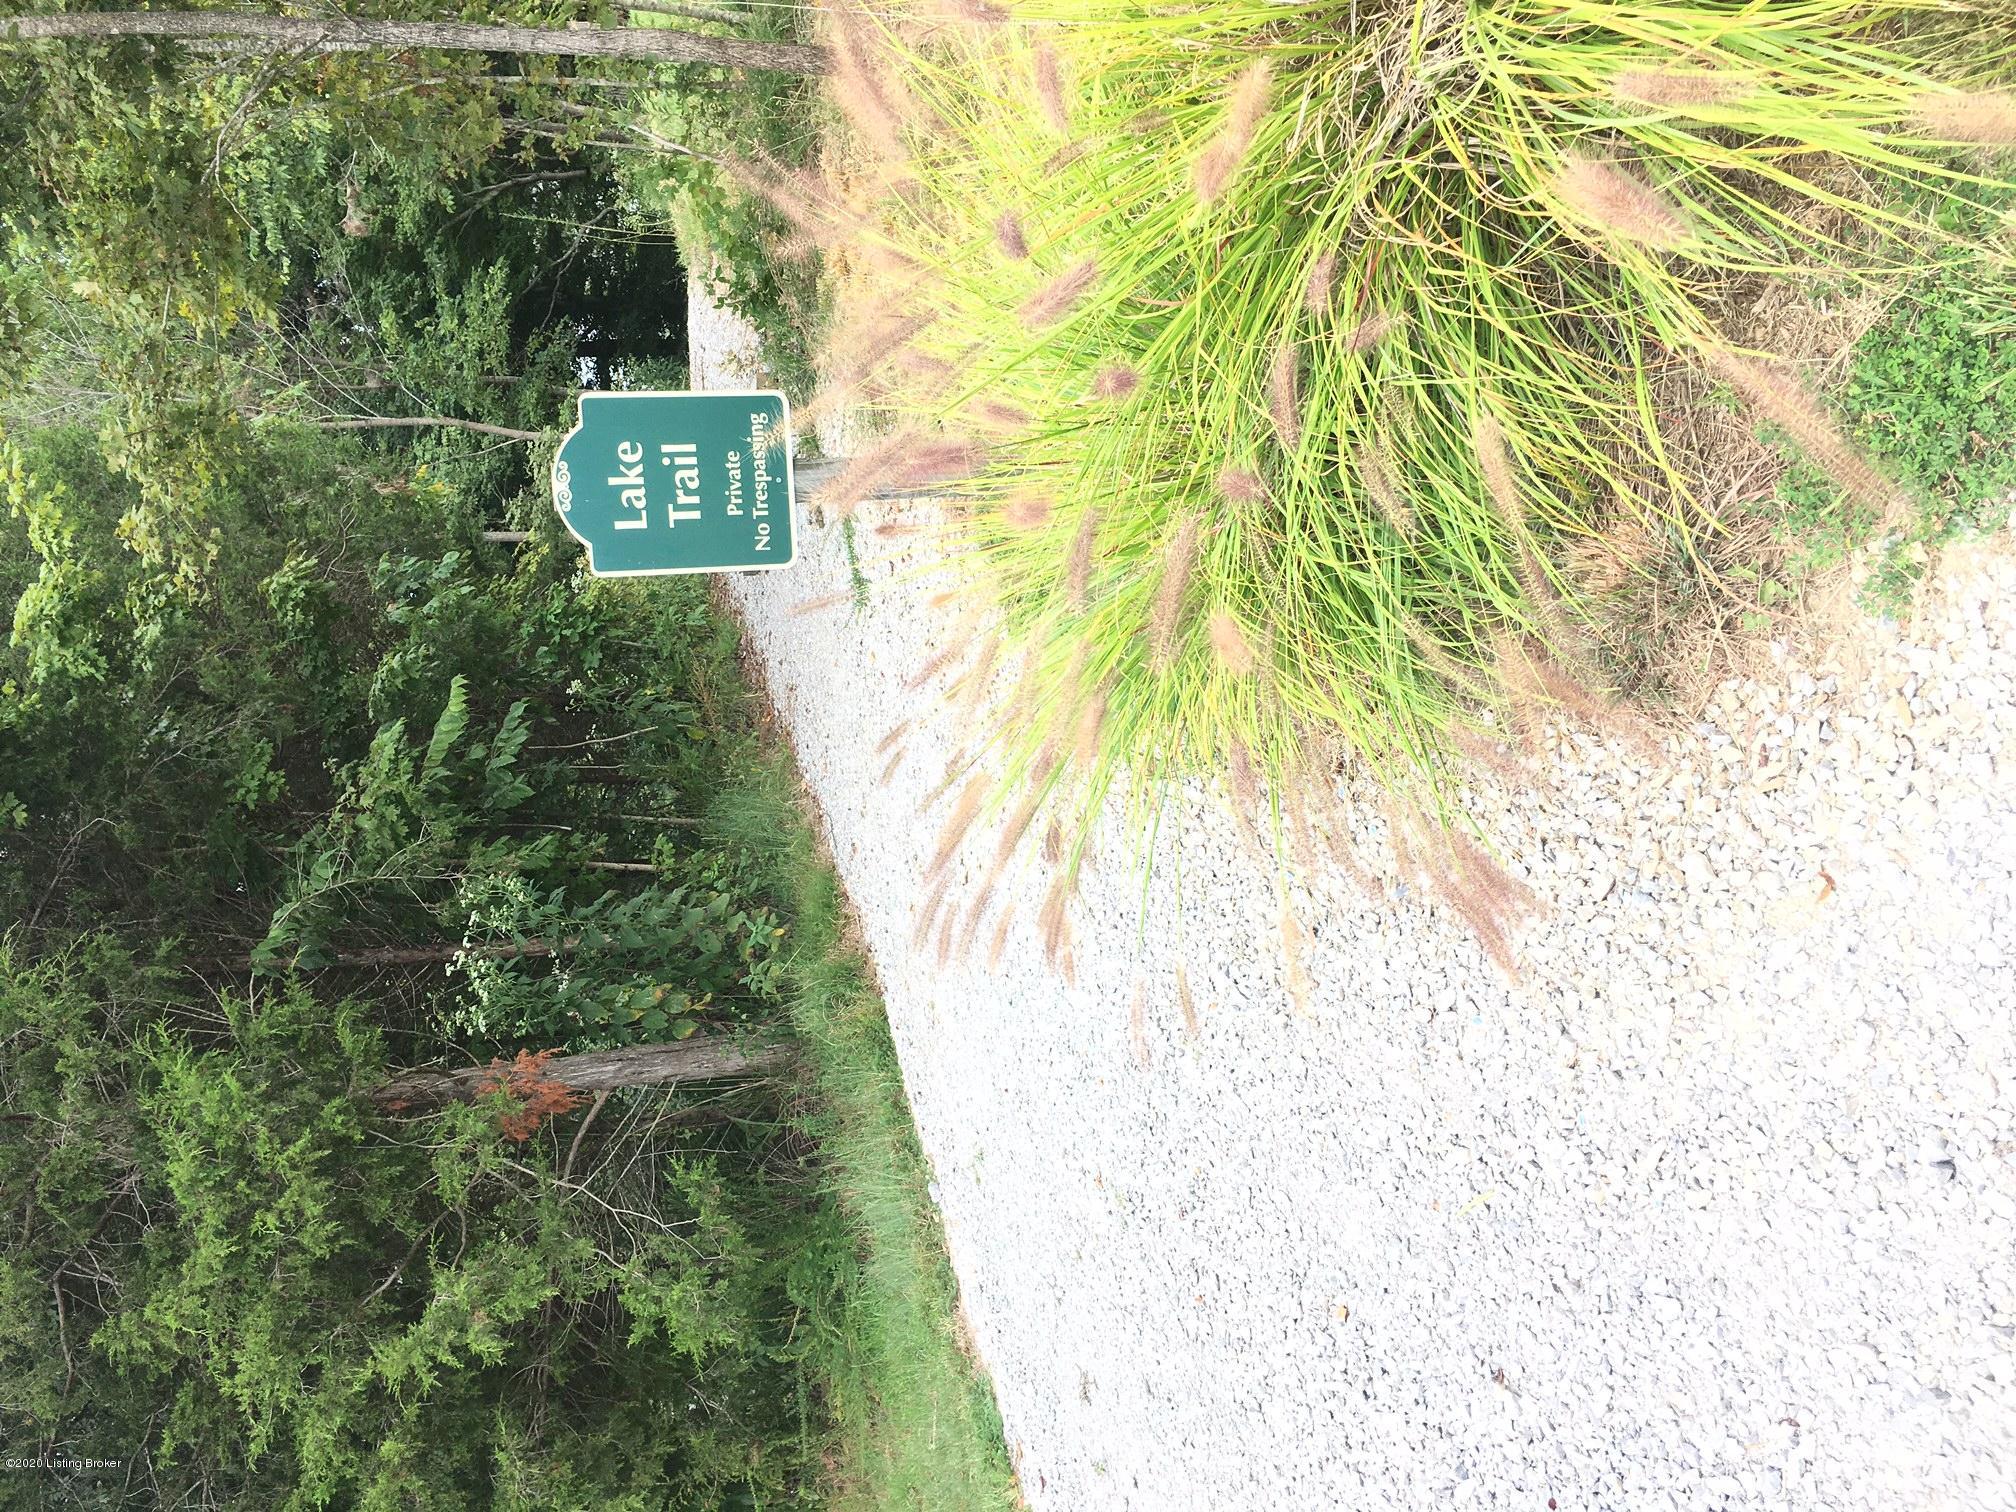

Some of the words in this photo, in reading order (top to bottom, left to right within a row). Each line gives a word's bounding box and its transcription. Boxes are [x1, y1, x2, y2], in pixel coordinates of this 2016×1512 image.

[608, 441, 648, 530] Lake
[660, 443, 701, 528] Trail
[725, 450, 743, 516] Private
[748, 412, 772, 519] Trespassing
[755, 523, 771, 551] No
